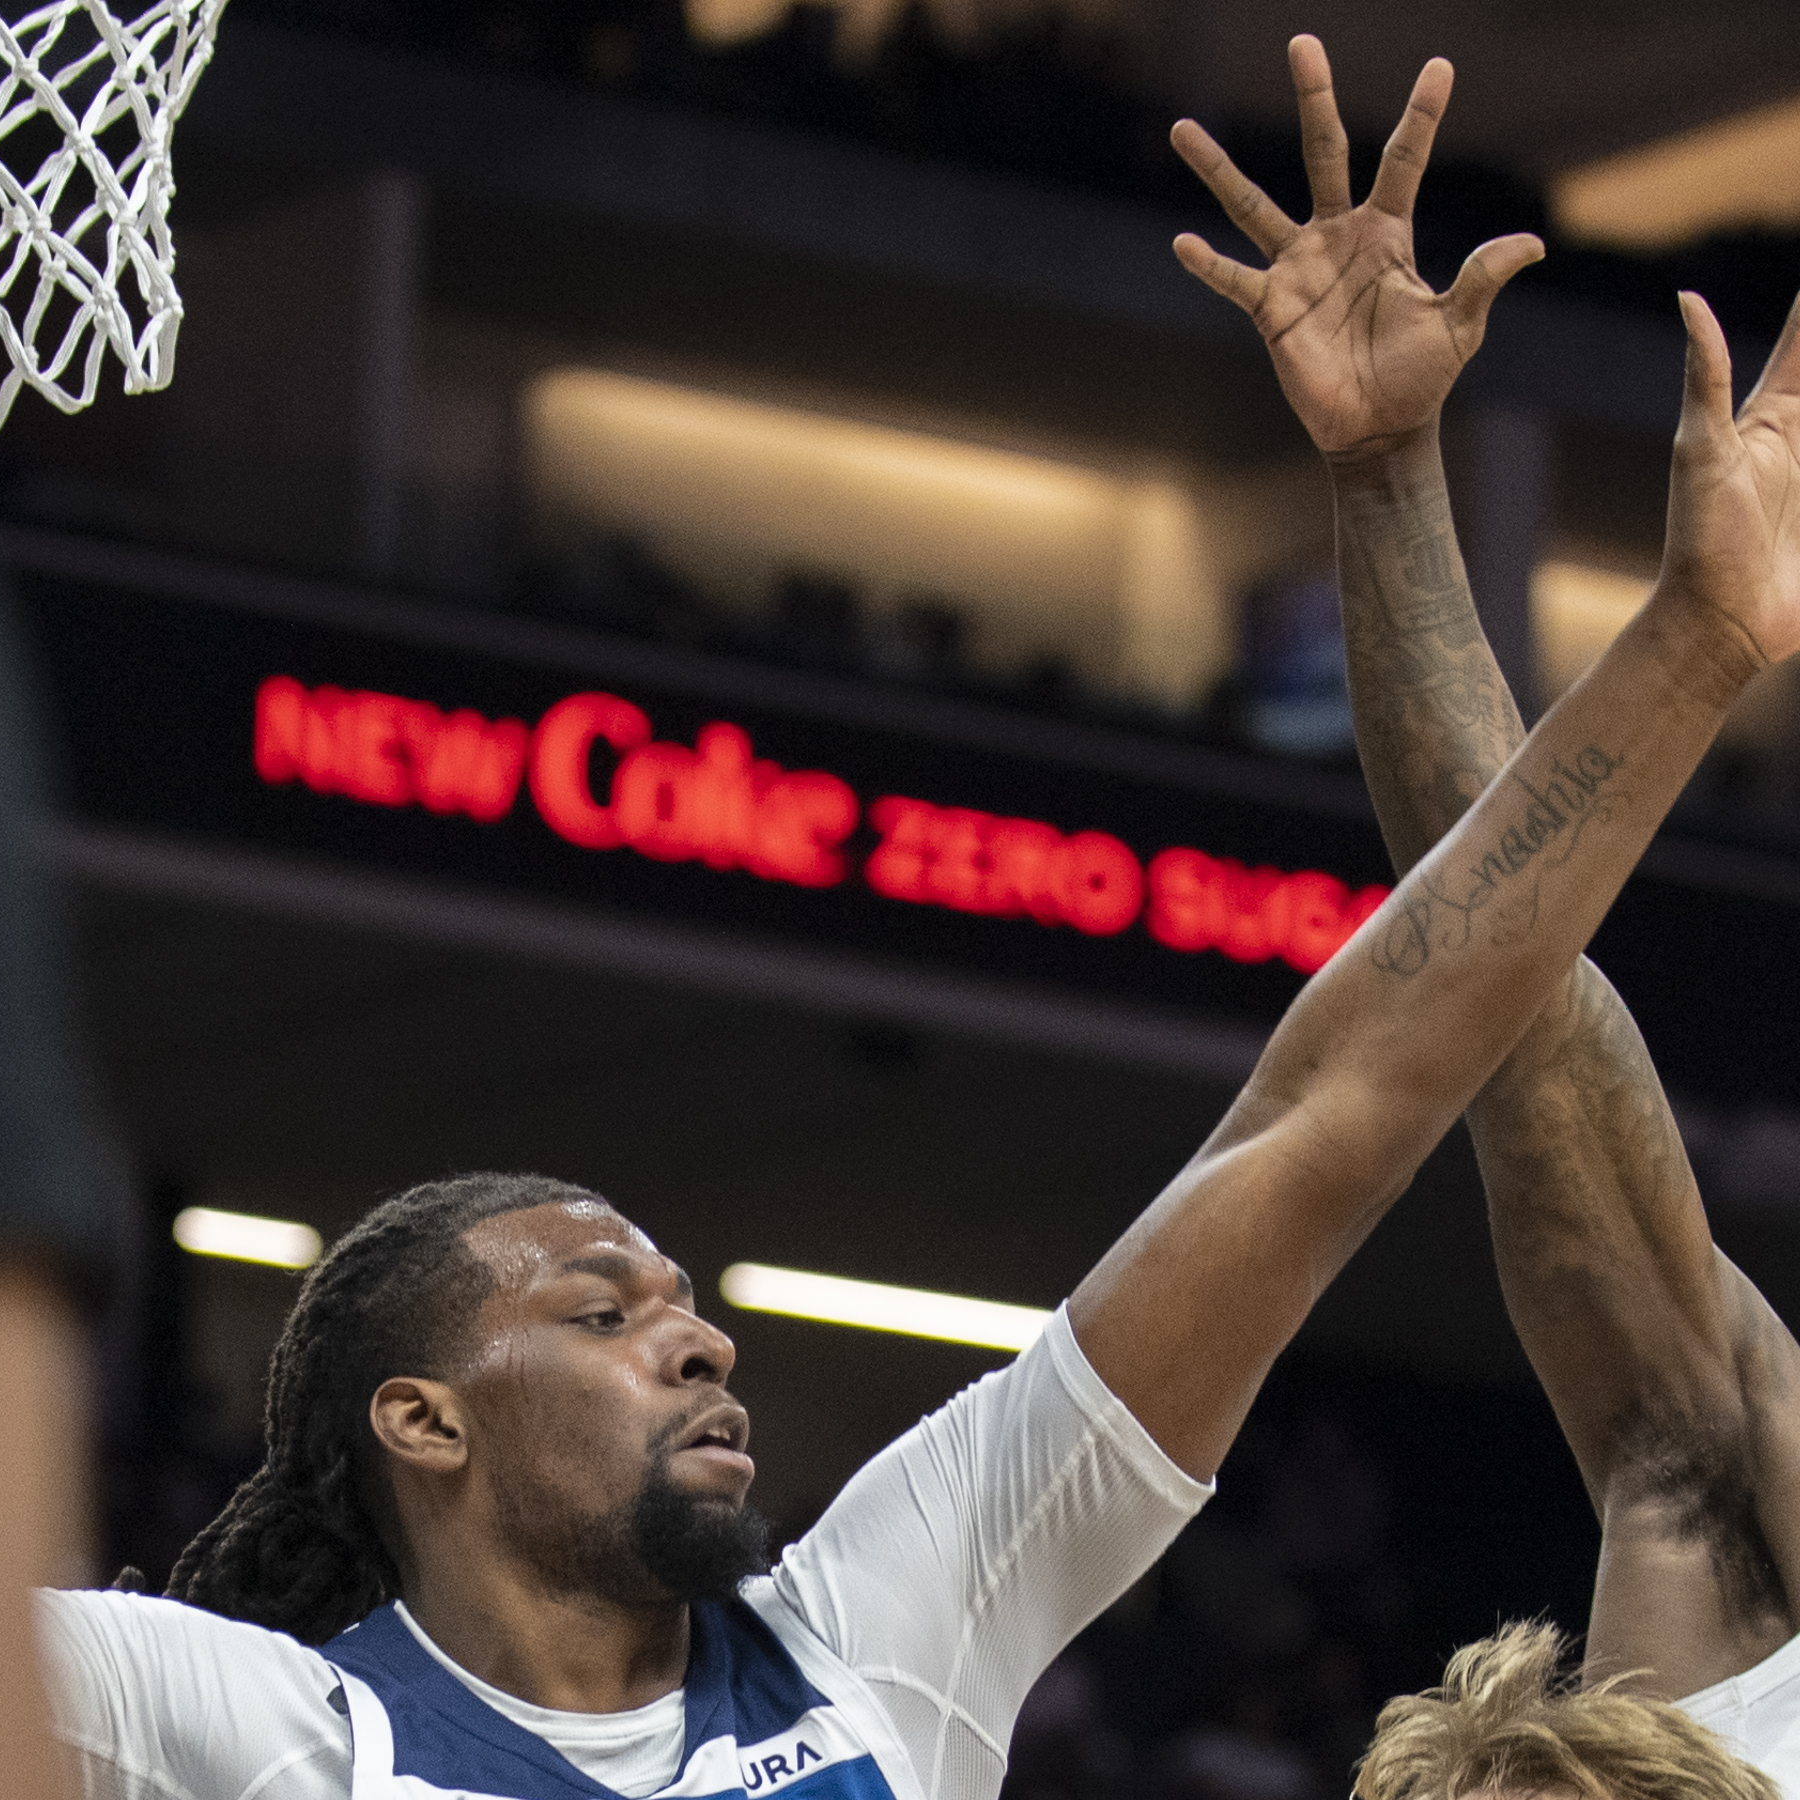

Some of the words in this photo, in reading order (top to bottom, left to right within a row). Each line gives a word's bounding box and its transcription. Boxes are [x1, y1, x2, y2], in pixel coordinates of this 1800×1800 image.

[254, 675, 530, 823] NEW
[528, 691, 859, 889] Coke
[865, 794, 1145, 937] ZERO
